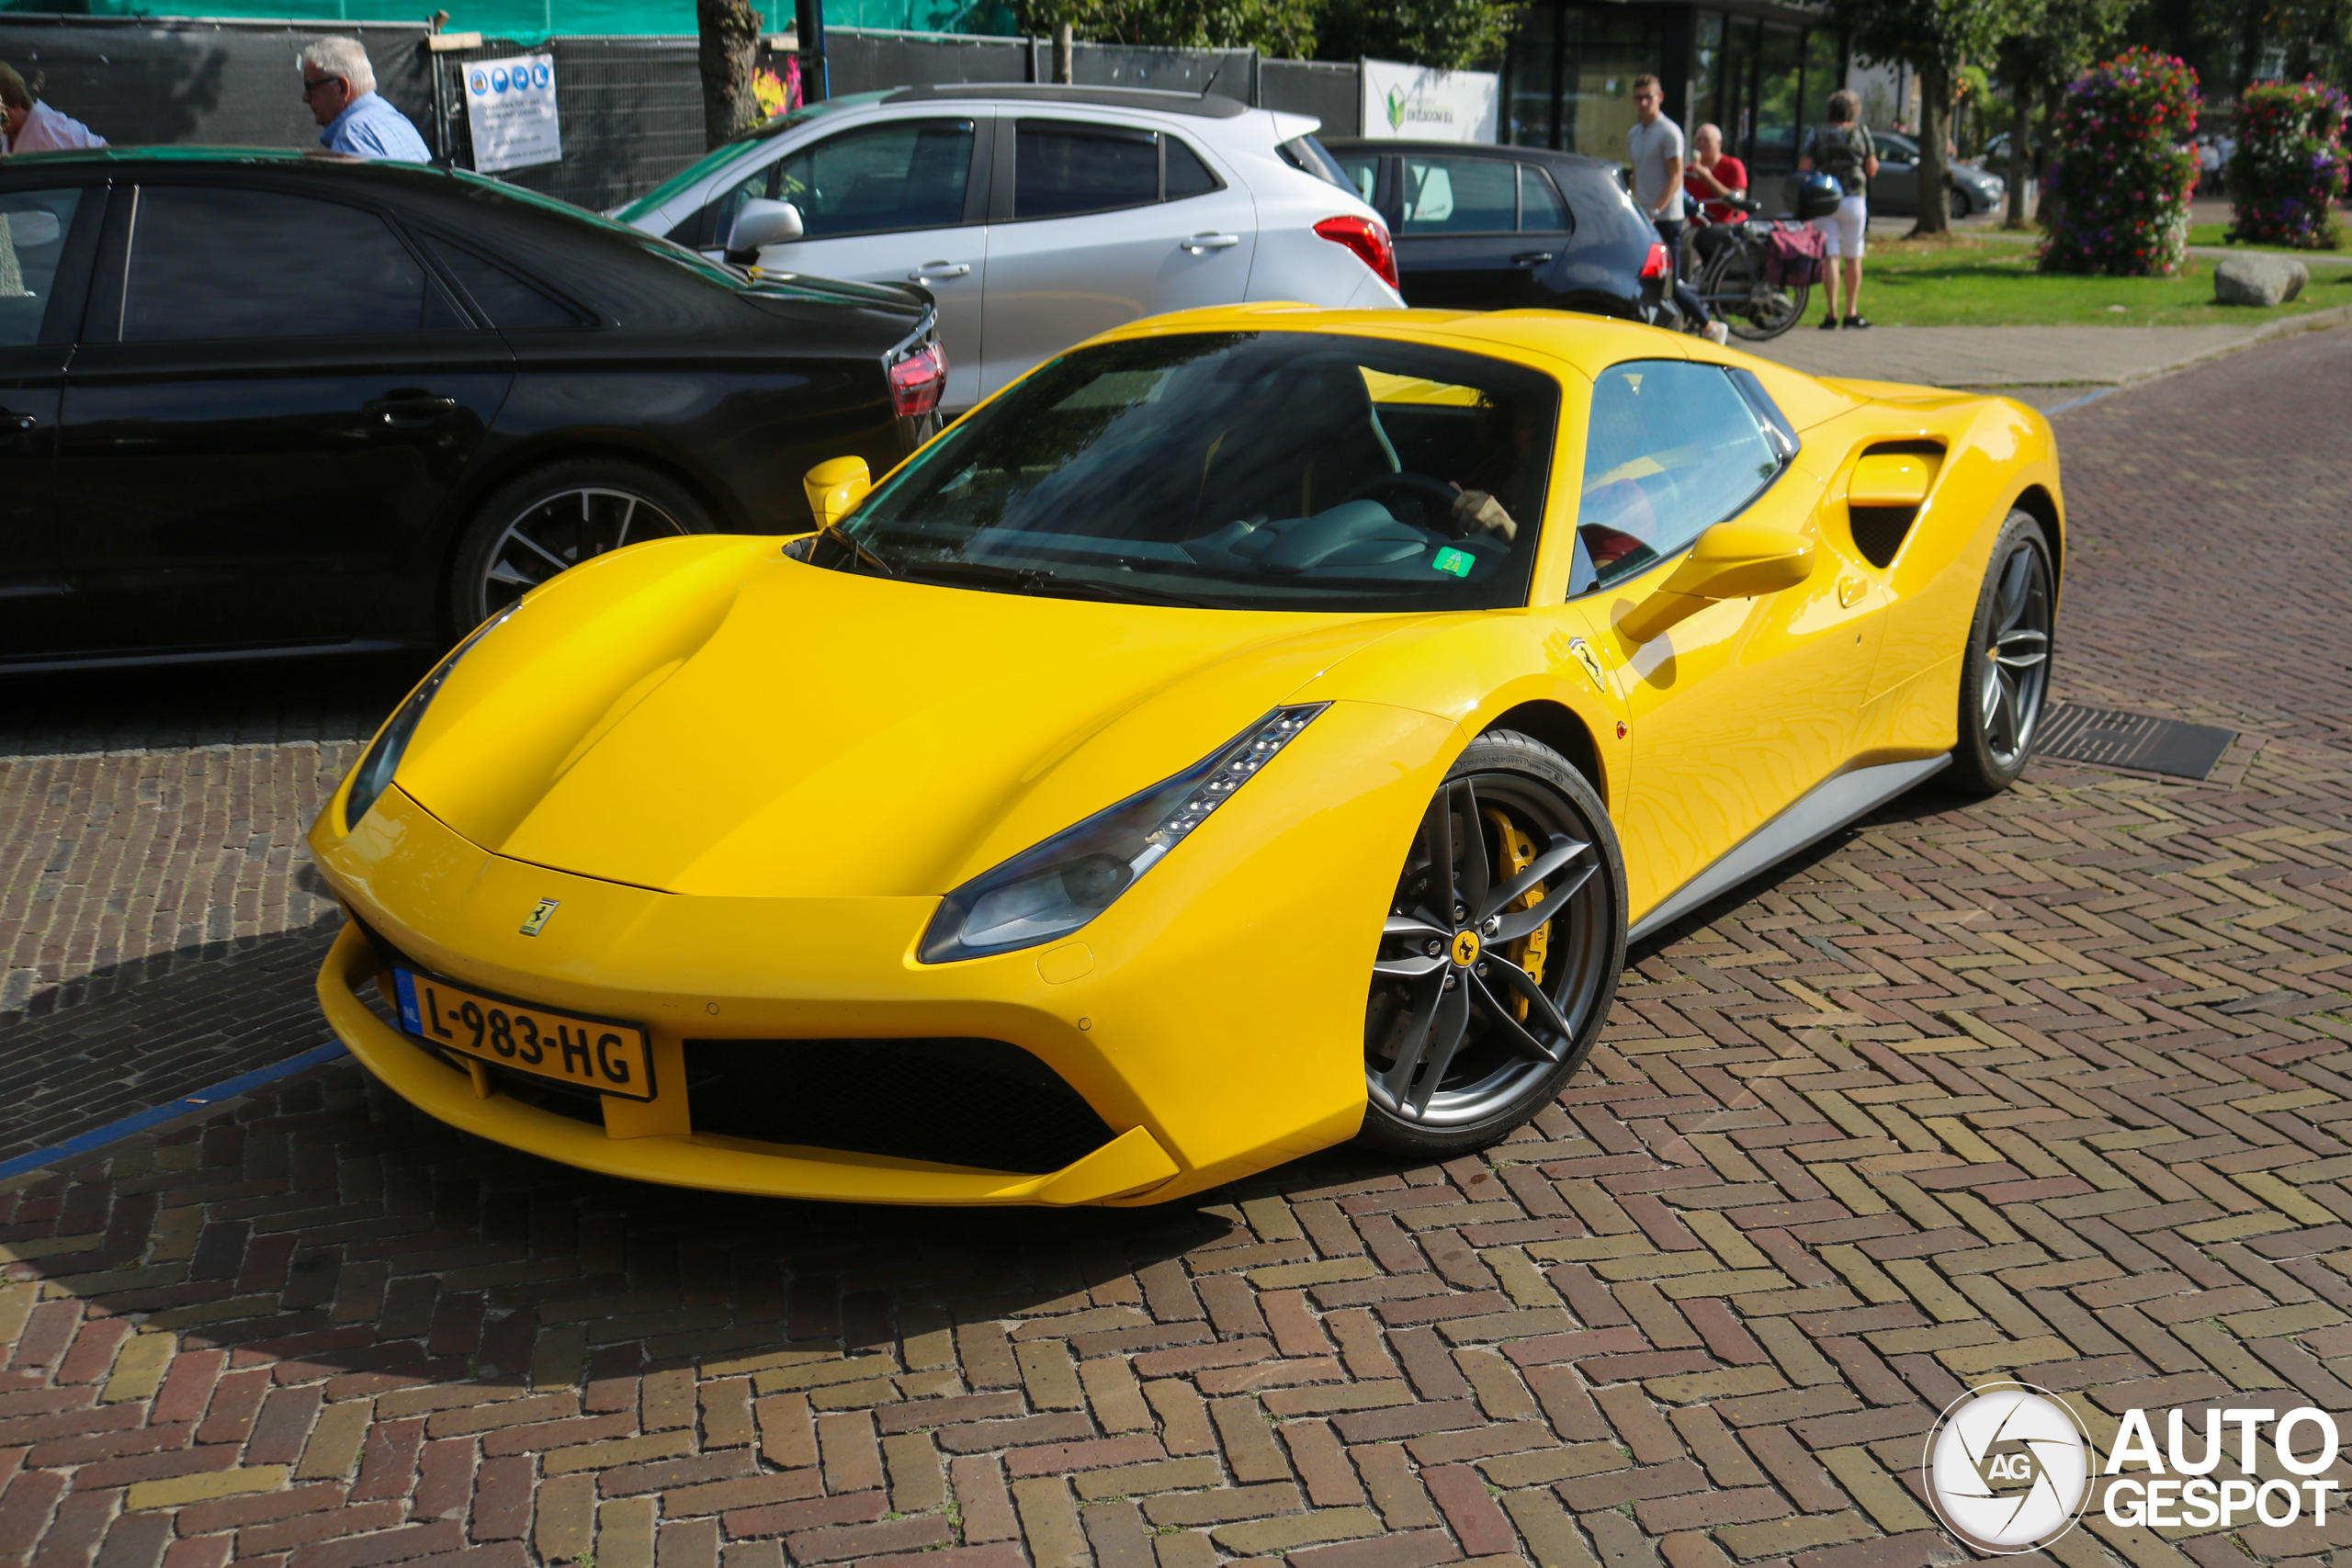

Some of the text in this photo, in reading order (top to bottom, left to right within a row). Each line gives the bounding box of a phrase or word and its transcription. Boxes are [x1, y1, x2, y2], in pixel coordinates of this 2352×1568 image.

[1442, 558, 1461, 573] 24
[402, 1005, 420, 1023] NL
[425, 987, 630, 1084] L-983-HG
